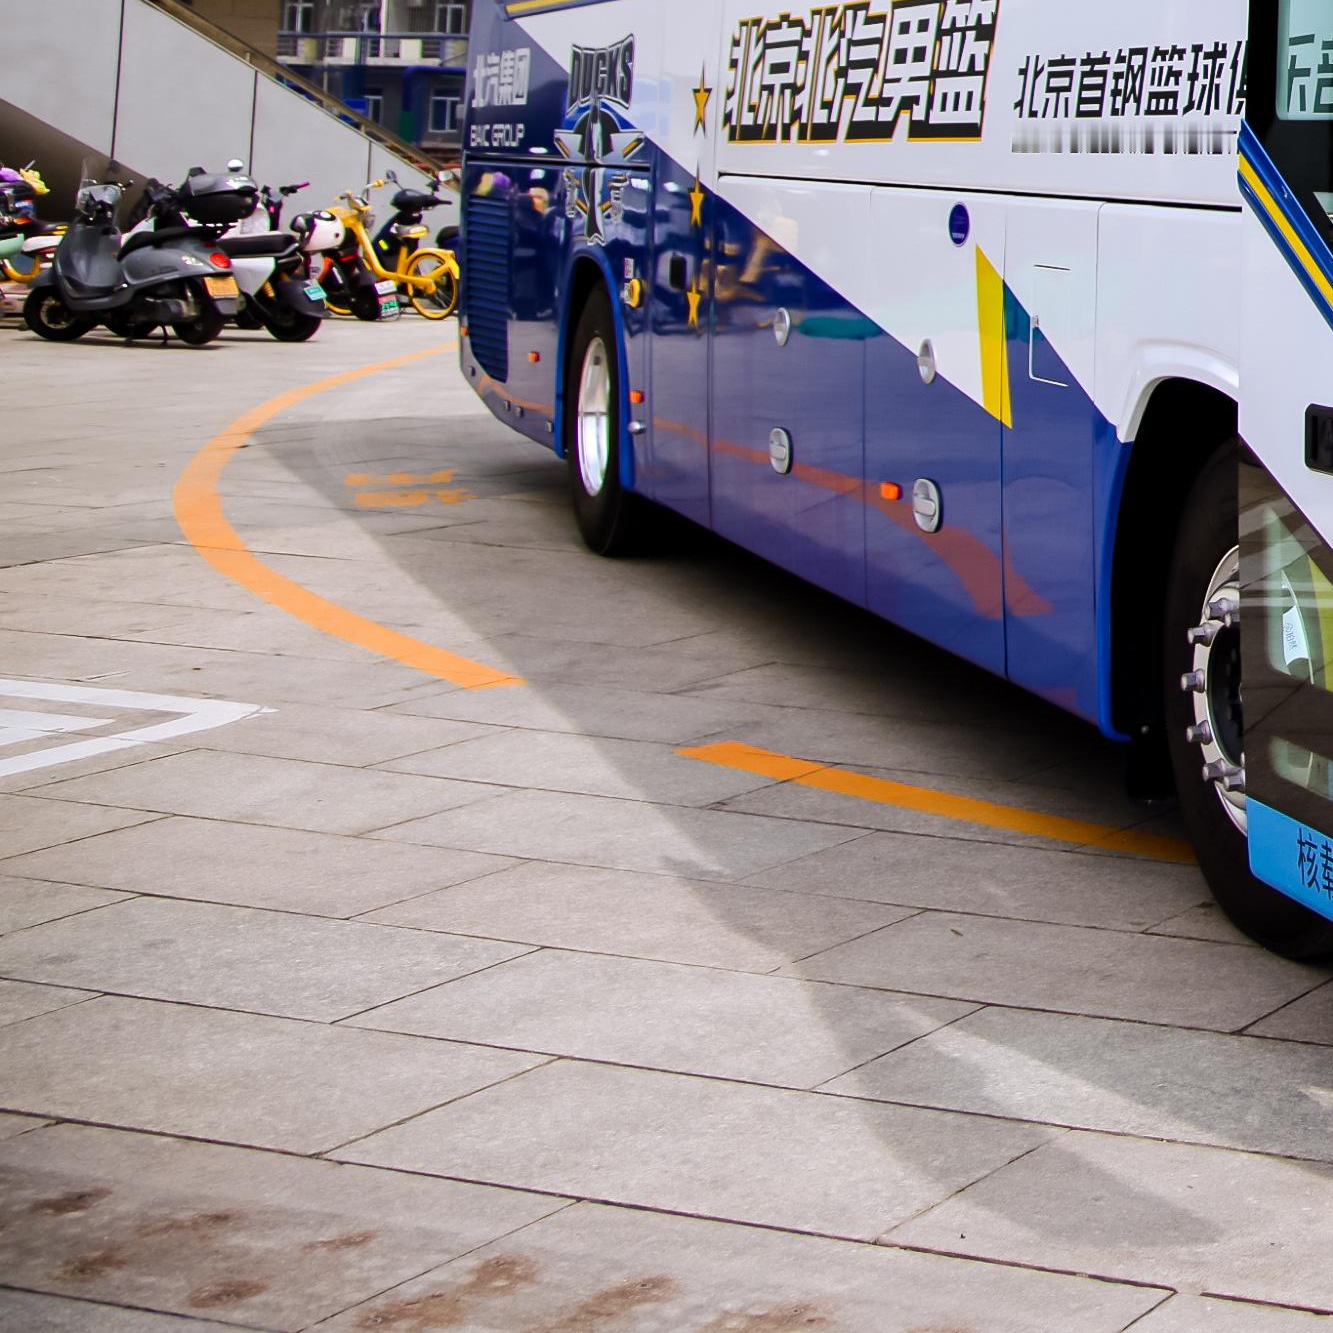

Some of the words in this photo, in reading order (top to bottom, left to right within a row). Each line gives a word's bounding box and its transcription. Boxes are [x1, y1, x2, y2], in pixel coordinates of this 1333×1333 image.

[472, 48, 530, 108] 北汽集团
[566, 33, 634, 115] DUCKS
[470, 125, 489, 147] BAIC
[492, 123, 525, 147] GROUP
